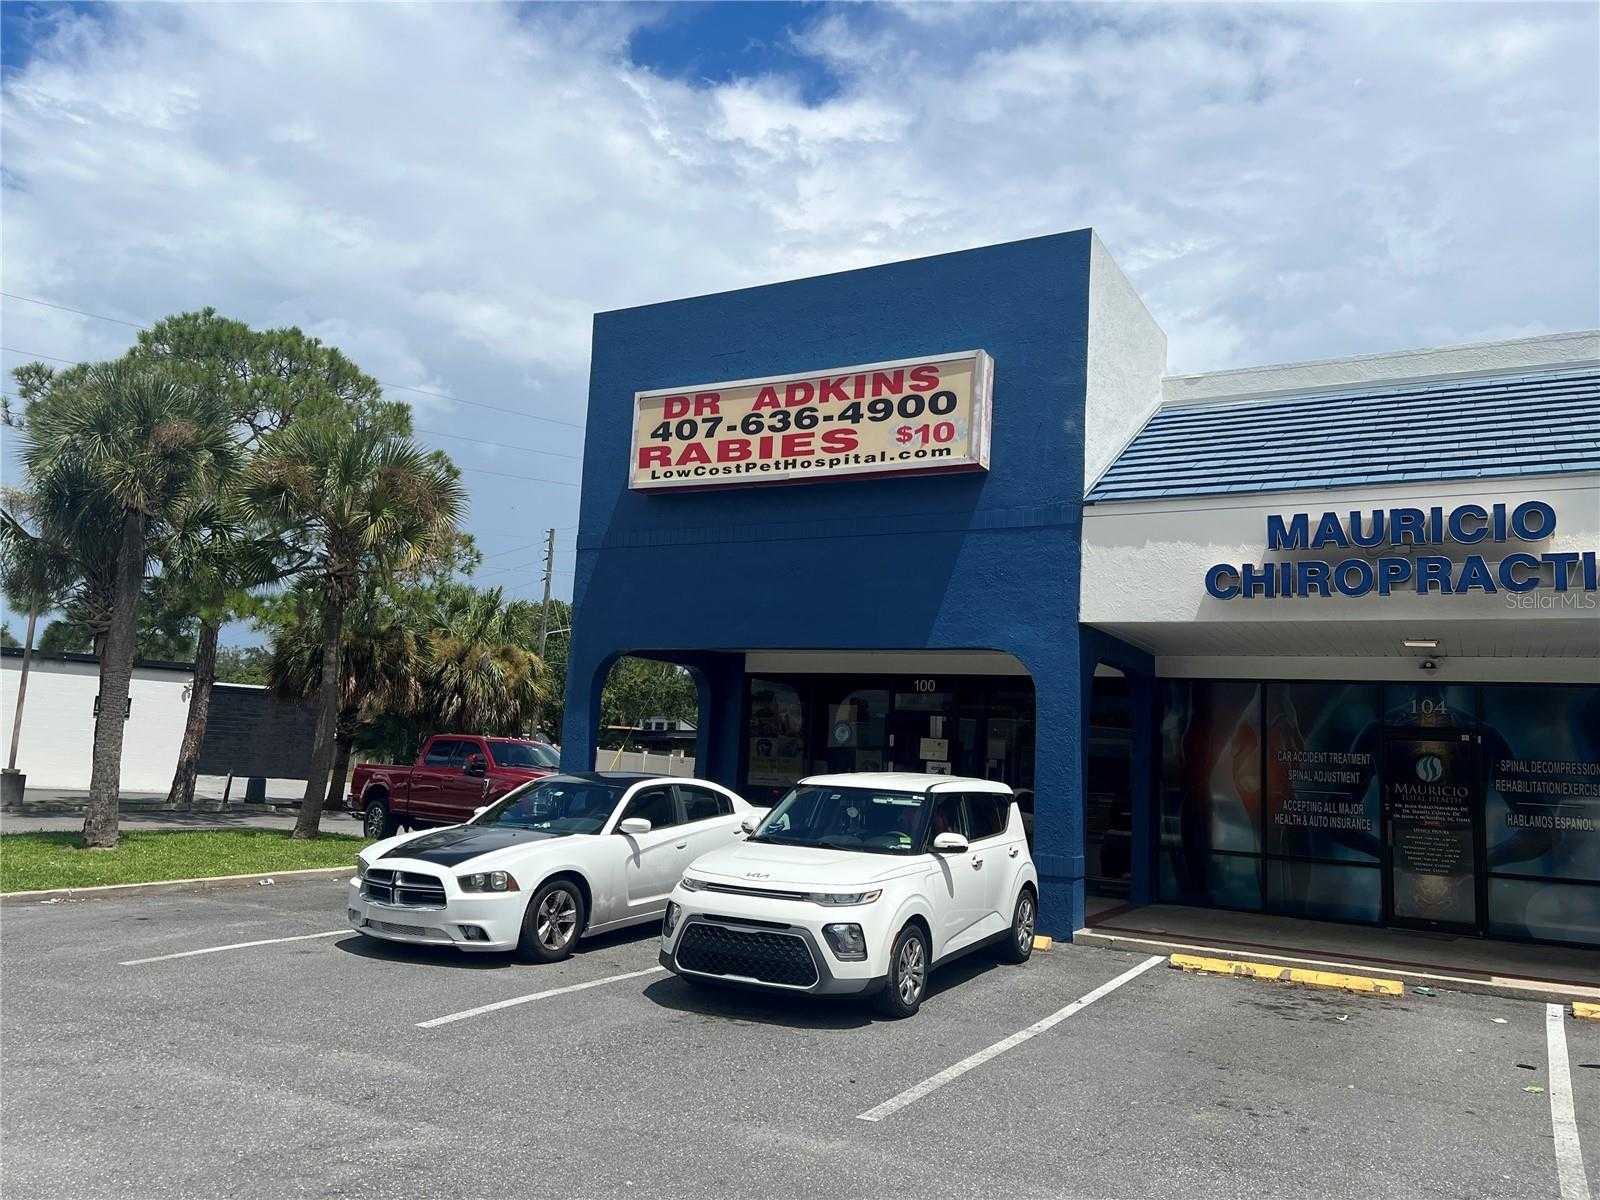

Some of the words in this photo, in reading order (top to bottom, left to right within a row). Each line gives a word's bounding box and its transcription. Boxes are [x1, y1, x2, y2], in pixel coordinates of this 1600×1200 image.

[663, 392, 721, 420] DR
[751, 366, 941, 411] ADKINS
[650, 390, 958, 442] 407-636-4900
[638, 428, 859, 469] RABIES
[896, 421, 956, 446] $10
[651, 446, 952, 480] LowCostPetHospital.com
[1267, 500, 1557, 551] MAURICIO
[1204, 551, 1598, 600] CHIROPRACTI
[914, 680, 936, 692] 100
[1409, 698, 1448, 715] 104
[1278, 752, 1293, 762] CAR
[1293, 752, 1328, 764] ACCIDENT
[1329, 752, 1371, 765] TREATMENT
[1501, 760, 1530, 773] SPINAL
[1288, 769, 1312, 781] SPINAL
[1313, 770, 1360, 784] ADJUSTMENT
[1394, 783, 1469, 798] MAURICIO
[1283, 800, 1322, 813] ACCEPTING
[1323, 802, 1337, 814] ALL
[1338, 802, 1364, 815] MAJOR
[1274, 813, 1302, 825] HEALTH
[1309, 815, 1329, 827] AUTO
[1329, 816, 1372, 831] INSURANCE
[1507, 814, 1553, 829] HABLAMOS
[1555, 816, 1594, 831] ESPAÑOL
